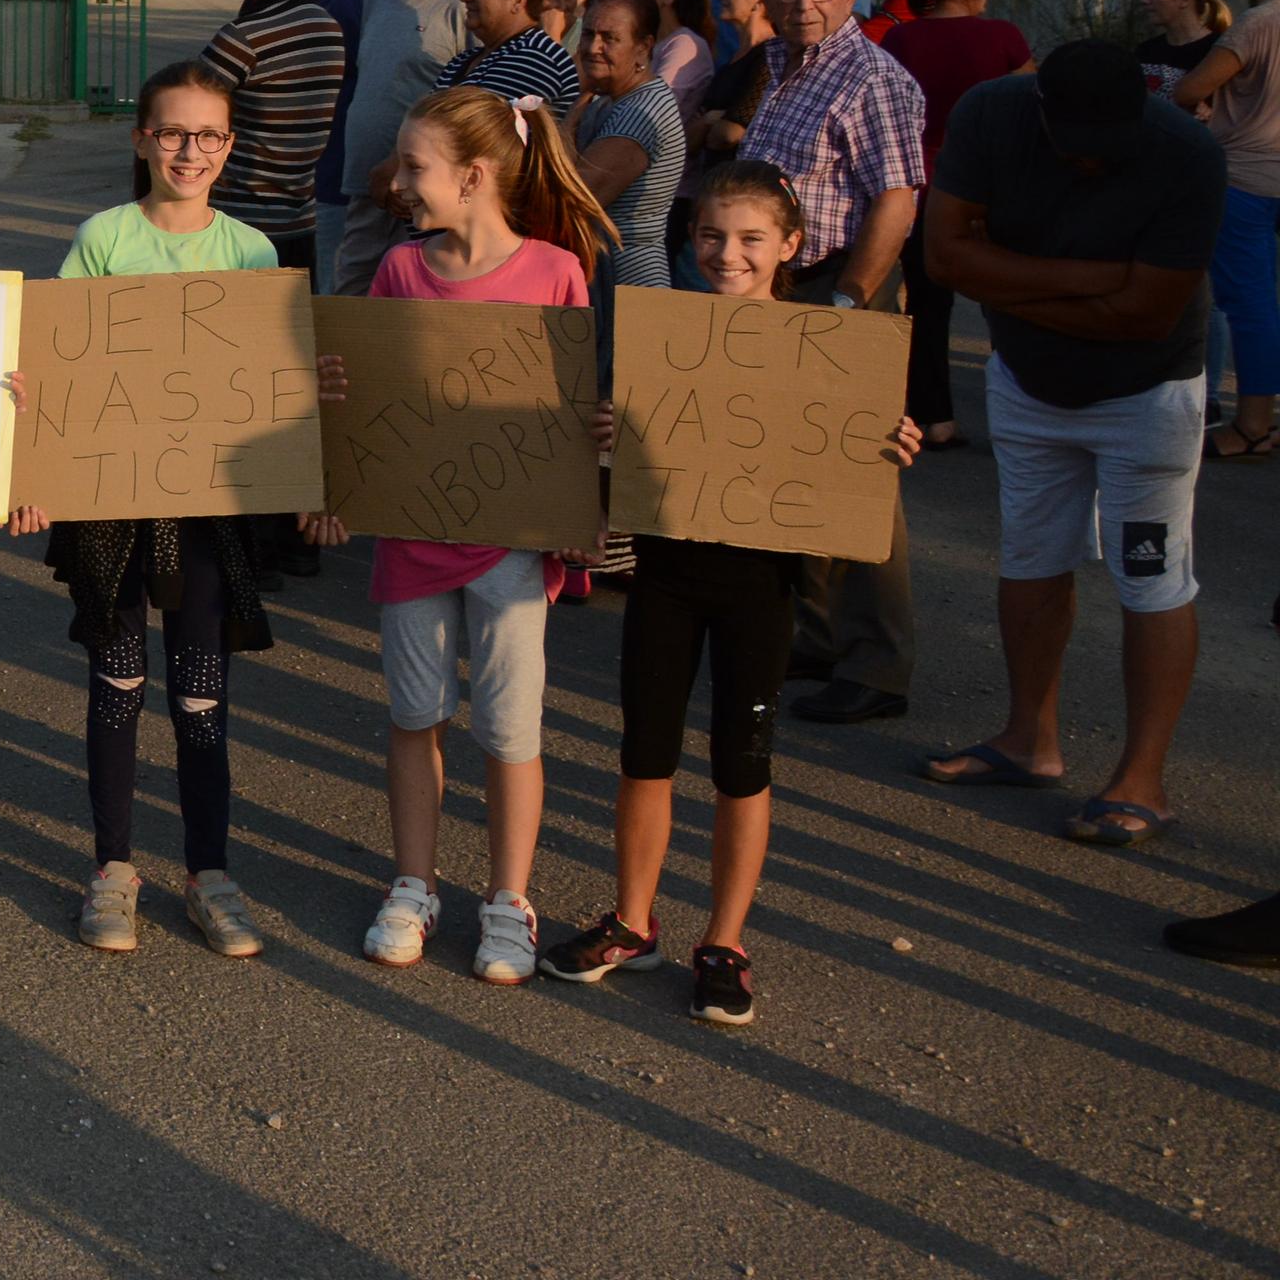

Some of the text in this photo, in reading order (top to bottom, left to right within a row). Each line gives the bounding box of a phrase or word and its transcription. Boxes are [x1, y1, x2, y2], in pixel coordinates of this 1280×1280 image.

[53, 279, 240, 361] JER
[665, 302, 850, 375] JER
[72, 431, 253, 505] TIČE
[401, 366, 598, 540] UBORAK
[636, 463, 824, 528] TIČE
